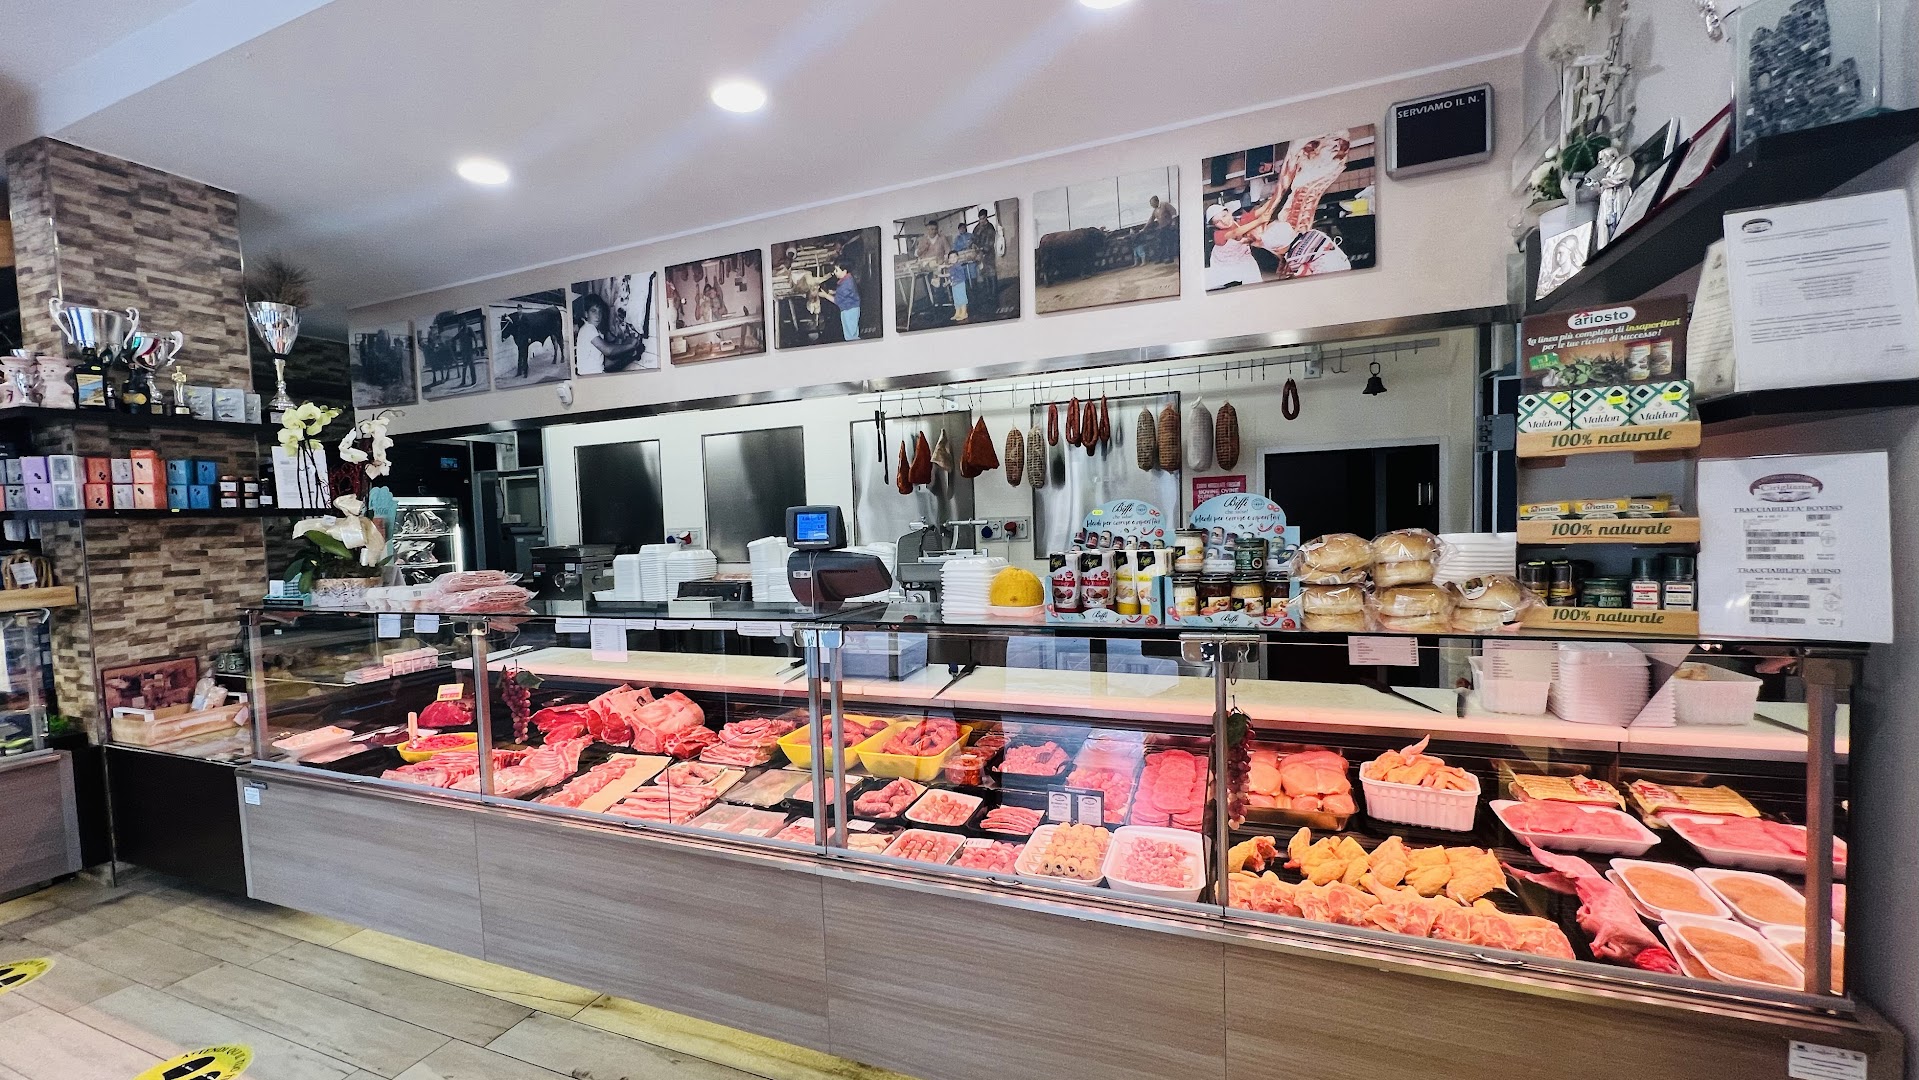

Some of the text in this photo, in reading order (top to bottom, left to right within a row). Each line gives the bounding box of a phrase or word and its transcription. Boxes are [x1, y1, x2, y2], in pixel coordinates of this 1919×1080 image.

[1397, 101, 1453, 119] SERVIAMO
[1456, 98, 1466, 107] IL
[1575, 310, 1629, 326] ariosto
[1538, 335, 1558, 345] linea
[1574, 328, 1614, 340] completa
[1615, 325, 1625, 334] di
[1625, 317, 1680, 332] insaporitori
[1542, 342, 1557, 352] per
[1566, 339, 1580, 348] tue
[1581, 336, 1608, 346] ricette
[1609, 334, 1618, 343] di
[1619, 329, 1662, 341] successo!
[1583, 414, 1620, 424] Maldon
[1640, 410, 1679, 421] Maldon
[1528, 419, 1562, 429] Maldon
[1551, 428, 1672, 448] 100% naturale
[1112, 501, 1135, 515] Biffi
[1224, 496, 1249, 510] Biffi
[1551, 522, 1672, 536] 100% naturale
[1737, 567, 1809, 575] TRACCIABILITA'
[1552, 608, 1665, 624] 100% naturale
